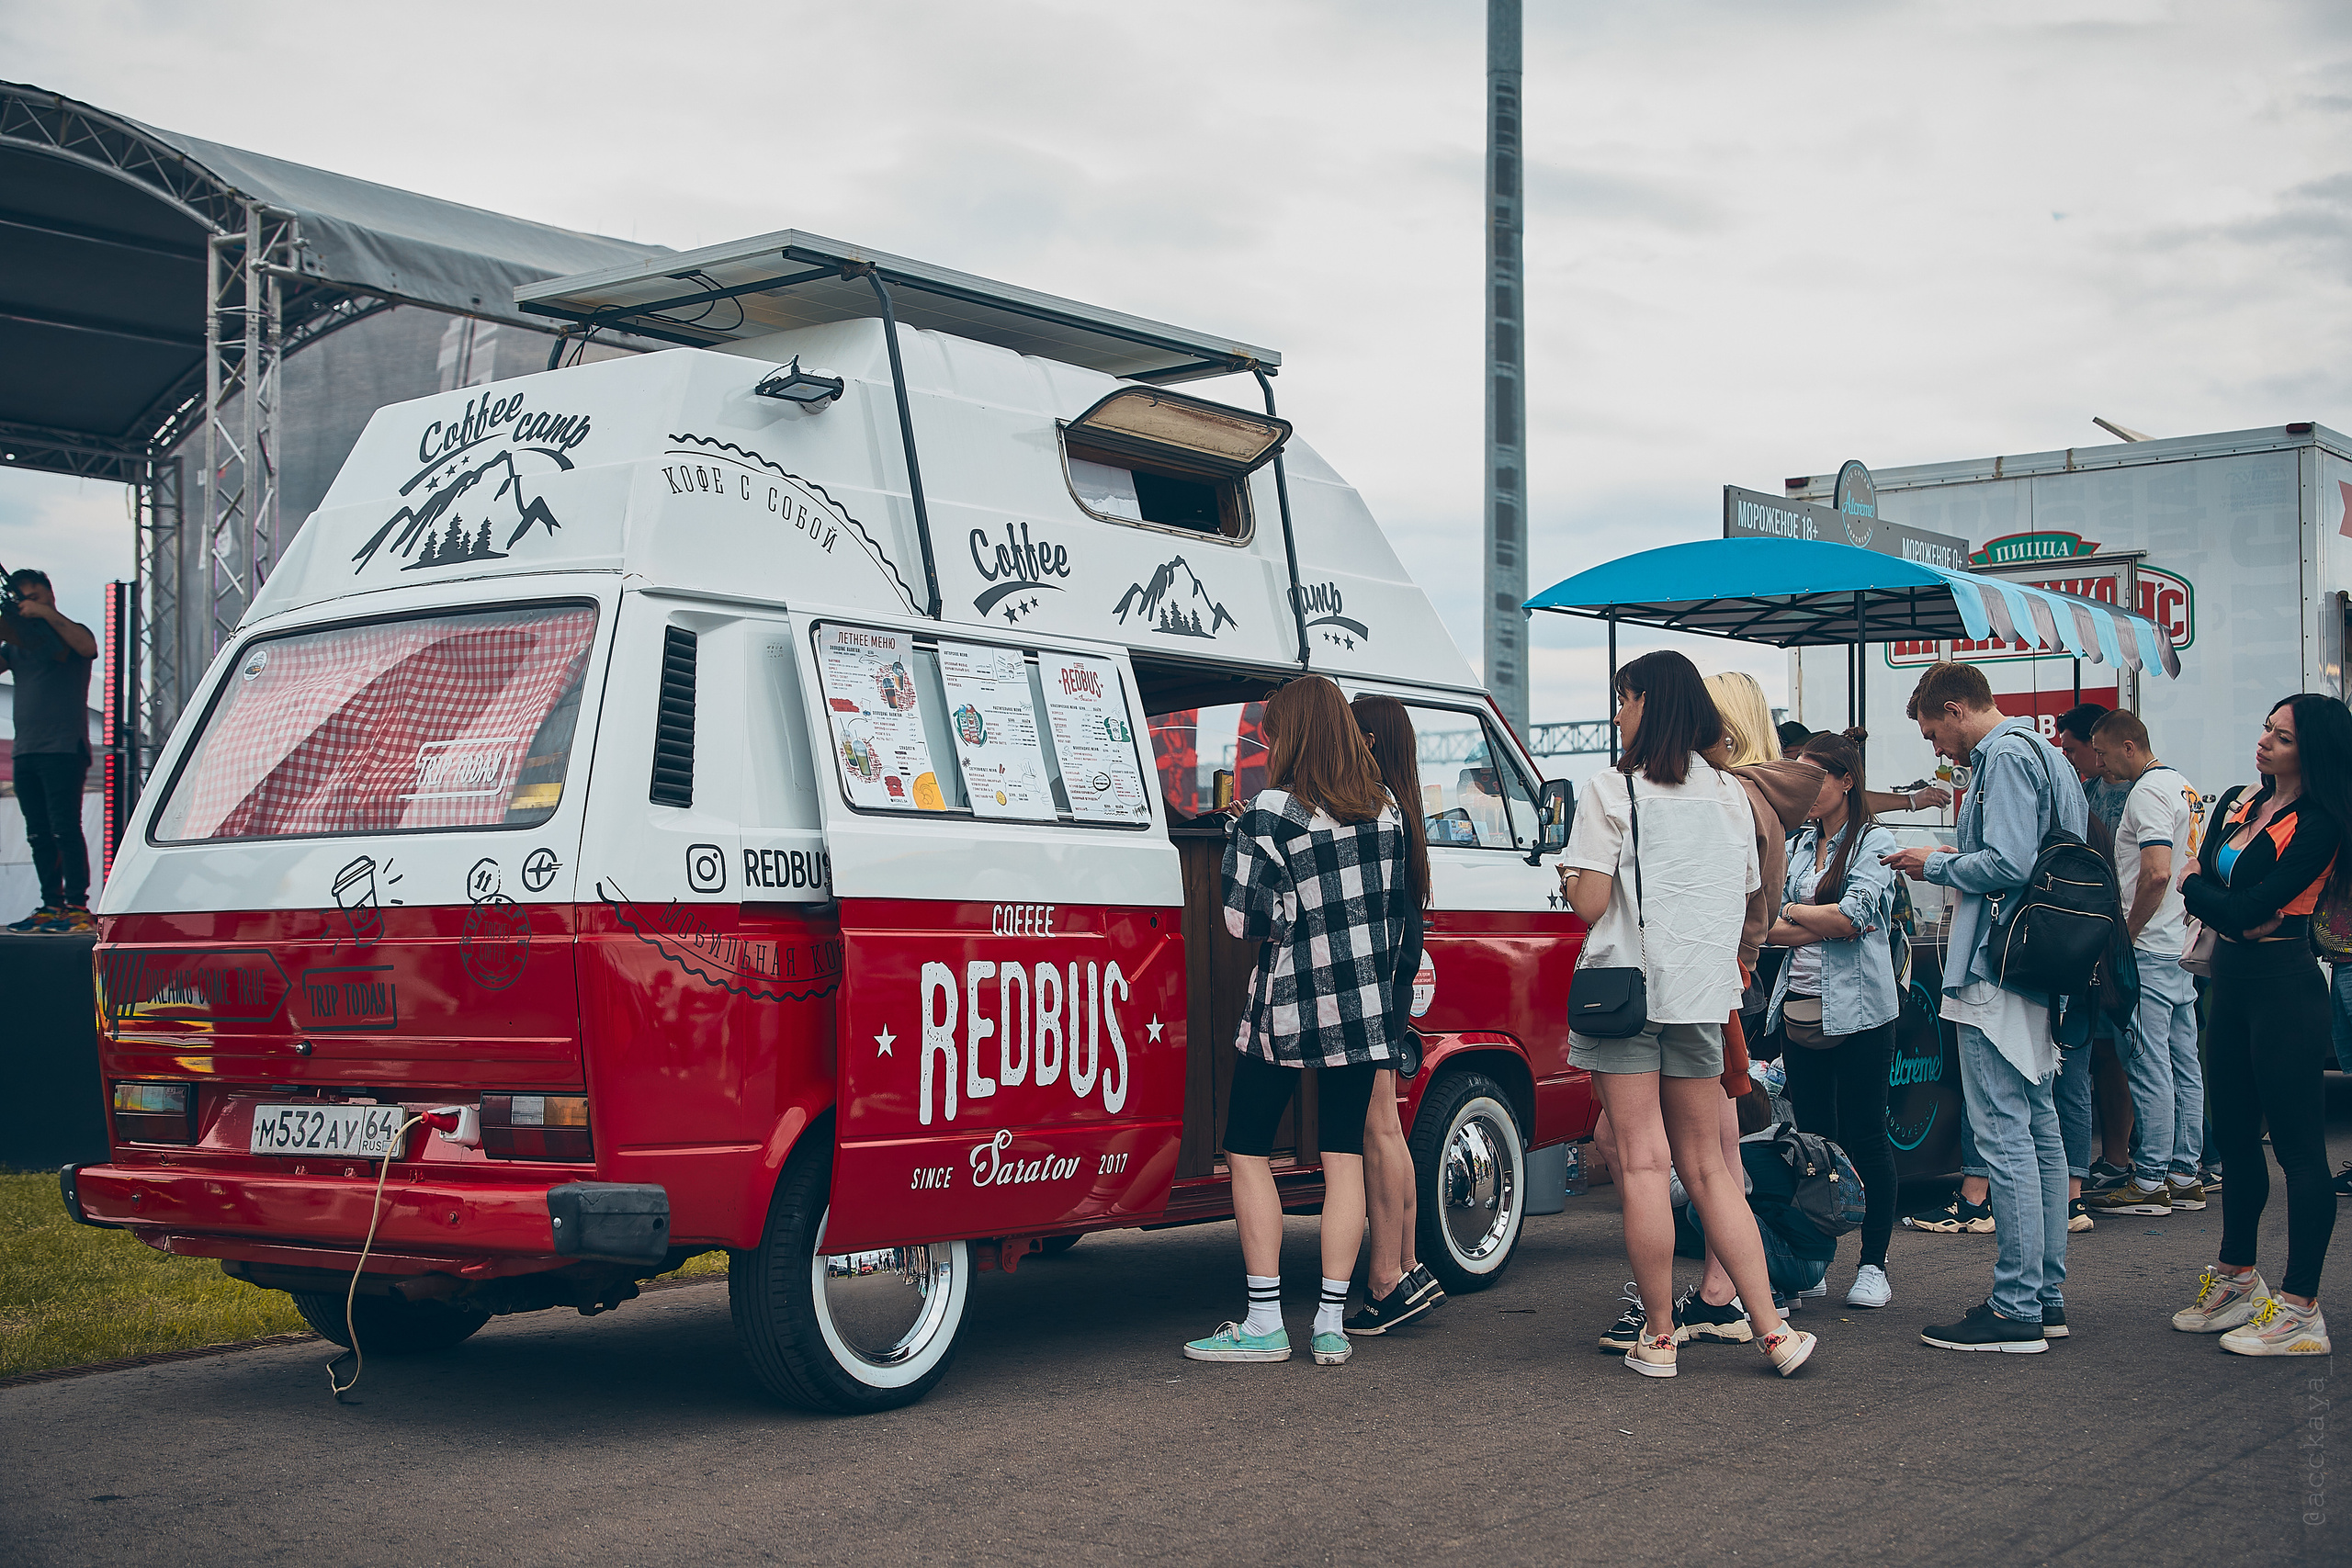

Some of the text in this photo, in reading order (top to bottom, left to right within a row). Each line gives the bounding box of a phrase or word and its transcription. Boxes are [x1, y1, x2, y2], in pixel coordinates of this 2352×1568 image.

[418, 390, 592, 463] Coffee camp
[661, 465, 725, 496] КОФЕ
[767, 486, 840, 555] СОБОЙ
[1737, 500, 1818, 541] МОРОЖЕНОЕ 18+
[968, 521, 1071, 582] Coffee
[1902, 537, 1951, 570] МОРОЖЕНОЕ
[1996, 540, 2070, 562] ПИЦЦА
[838, 631, 869, 647] ЛЕТНЕЕ
[870, 635, 896, 650] МЕНЮ
[1061, 668, 1102, 699] REDBUS
[415, 755, 453, 786] TRIP
[658, 897, 797, 977] МОБИЛЬНАЯ
[992, 904, 1057, 938] COFFEE
[479, 942, 507, 964] COFFEE
[145, 967, 268, 1006] DREAMS COME TRUE
[308, 981, 387, 1018] TRIP TODAY
[919, 960, 1129, 1126] REDBUS
[365, 1110, 391, 1140] 64
[362, 1141, 382, 1152] RUS
[910, 1129, 1129, 1190] SINCE Saratov 2017
[1364, 1303, 1379, 1316] ORS
